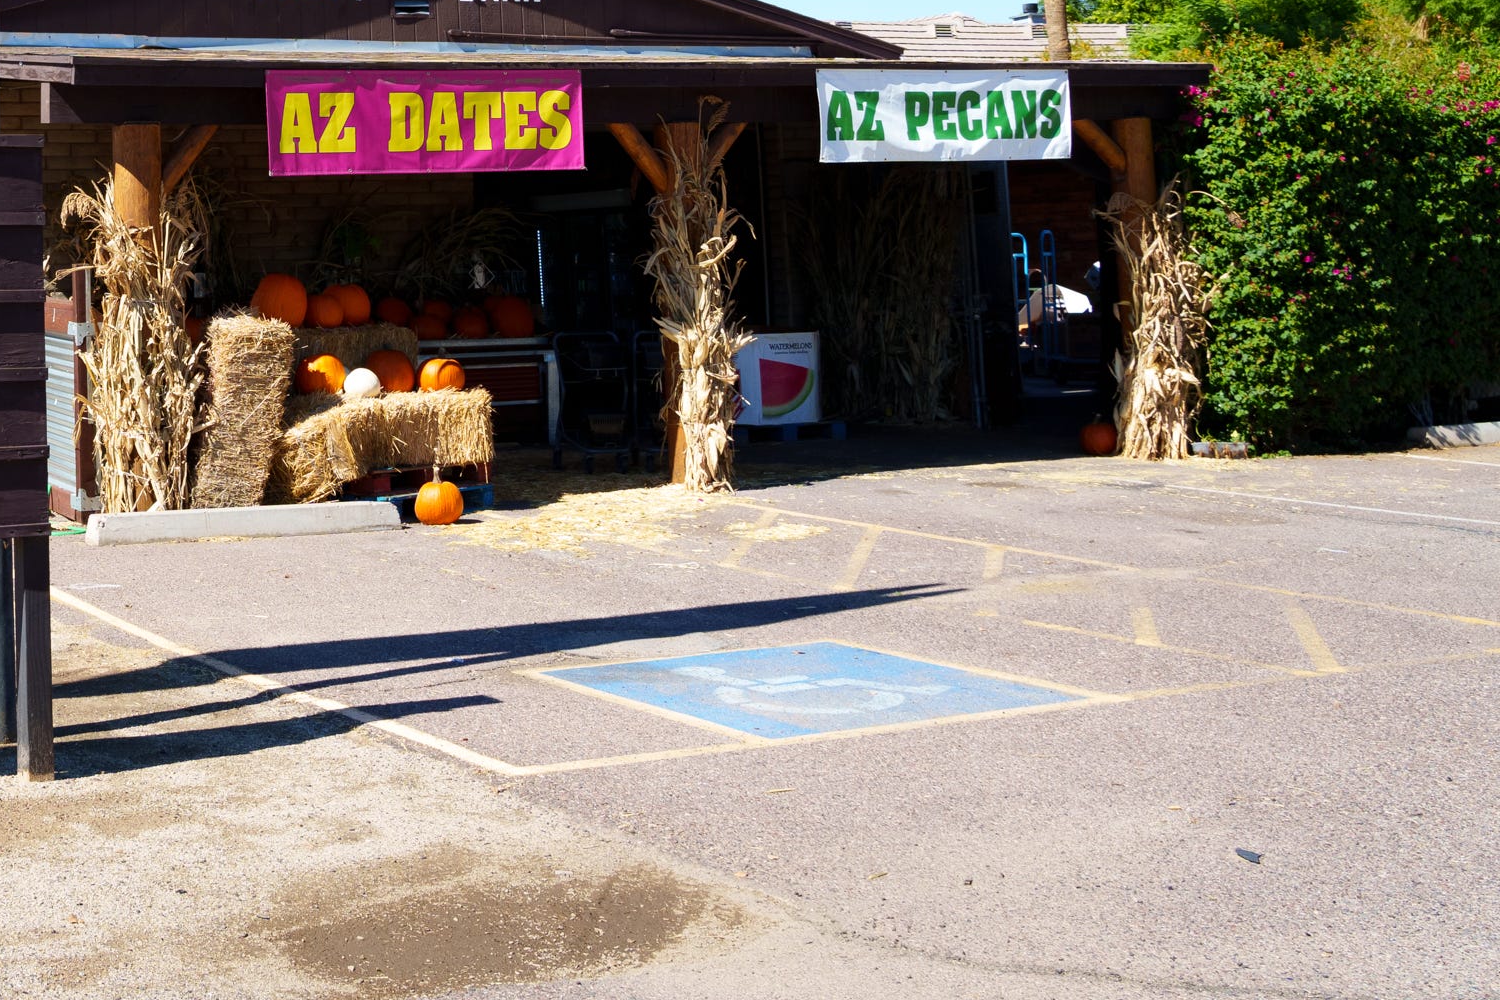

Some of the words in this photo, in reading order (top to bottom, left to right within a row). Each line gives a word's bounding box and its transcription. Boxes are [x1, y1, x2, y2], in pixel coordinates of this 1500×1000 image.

[279, 92, 356, 154] AZ
[388, 90, 572, 152] DATES
[827, 90, 885, 141] AZ
[904, 89, 1061, 141] PECANS
[768, 342, 813, 351] WATERMELONS
